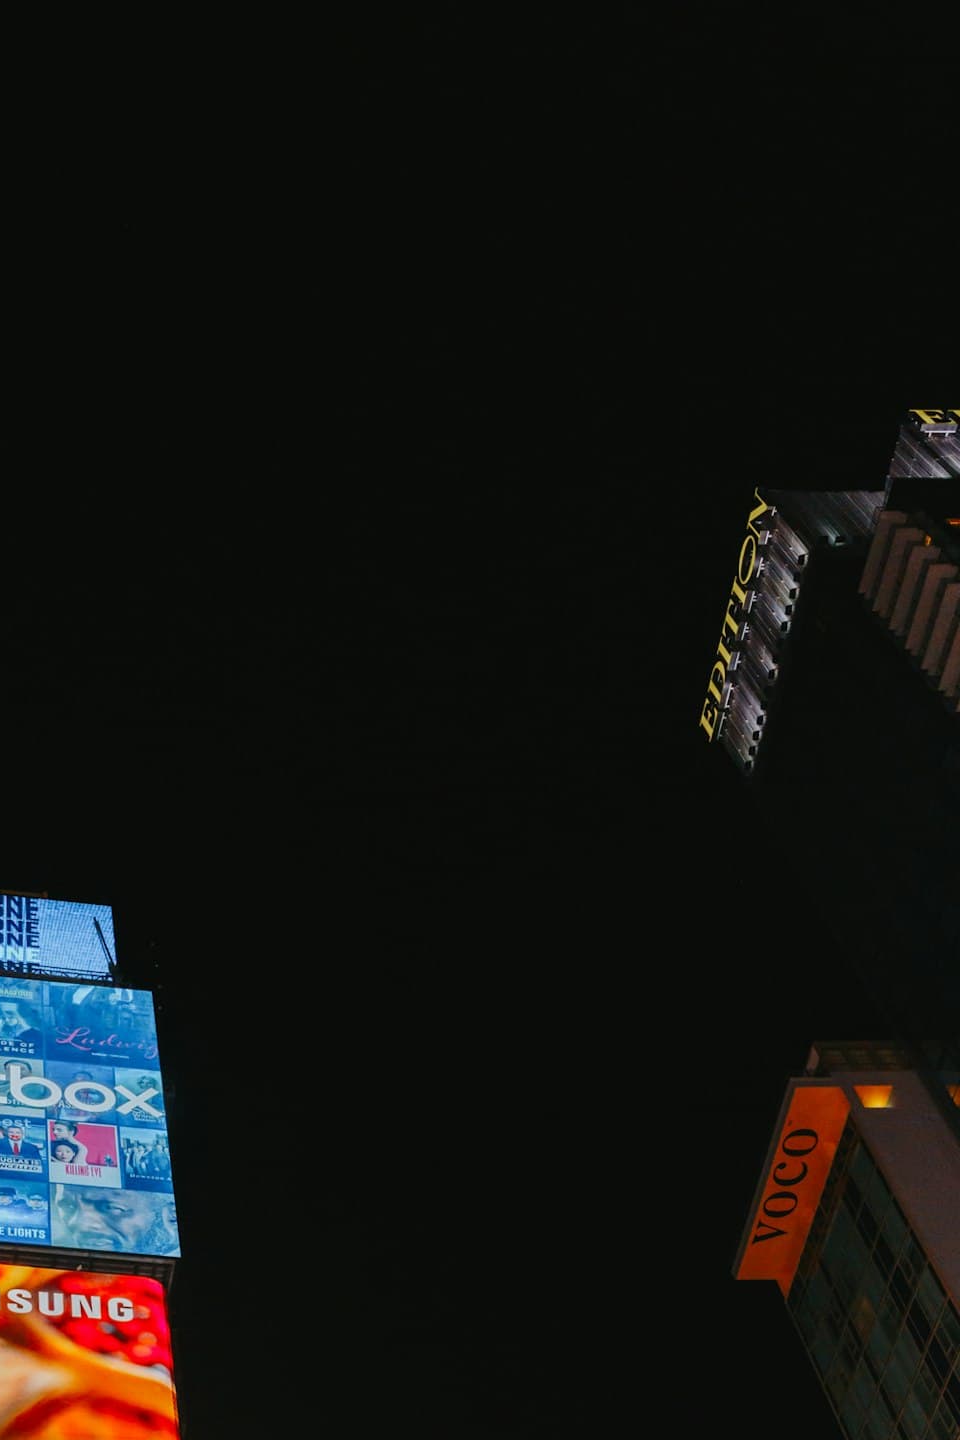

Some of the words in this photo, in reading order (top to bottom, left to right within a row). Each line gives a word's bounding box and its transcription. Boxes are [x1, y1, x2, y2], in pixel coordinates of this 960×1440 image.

[700, 486, 768, 743] EDITION
[55, 1026, 158, 1059] Ludwig
[7, 1226, 47, 1240] LIGHTS
